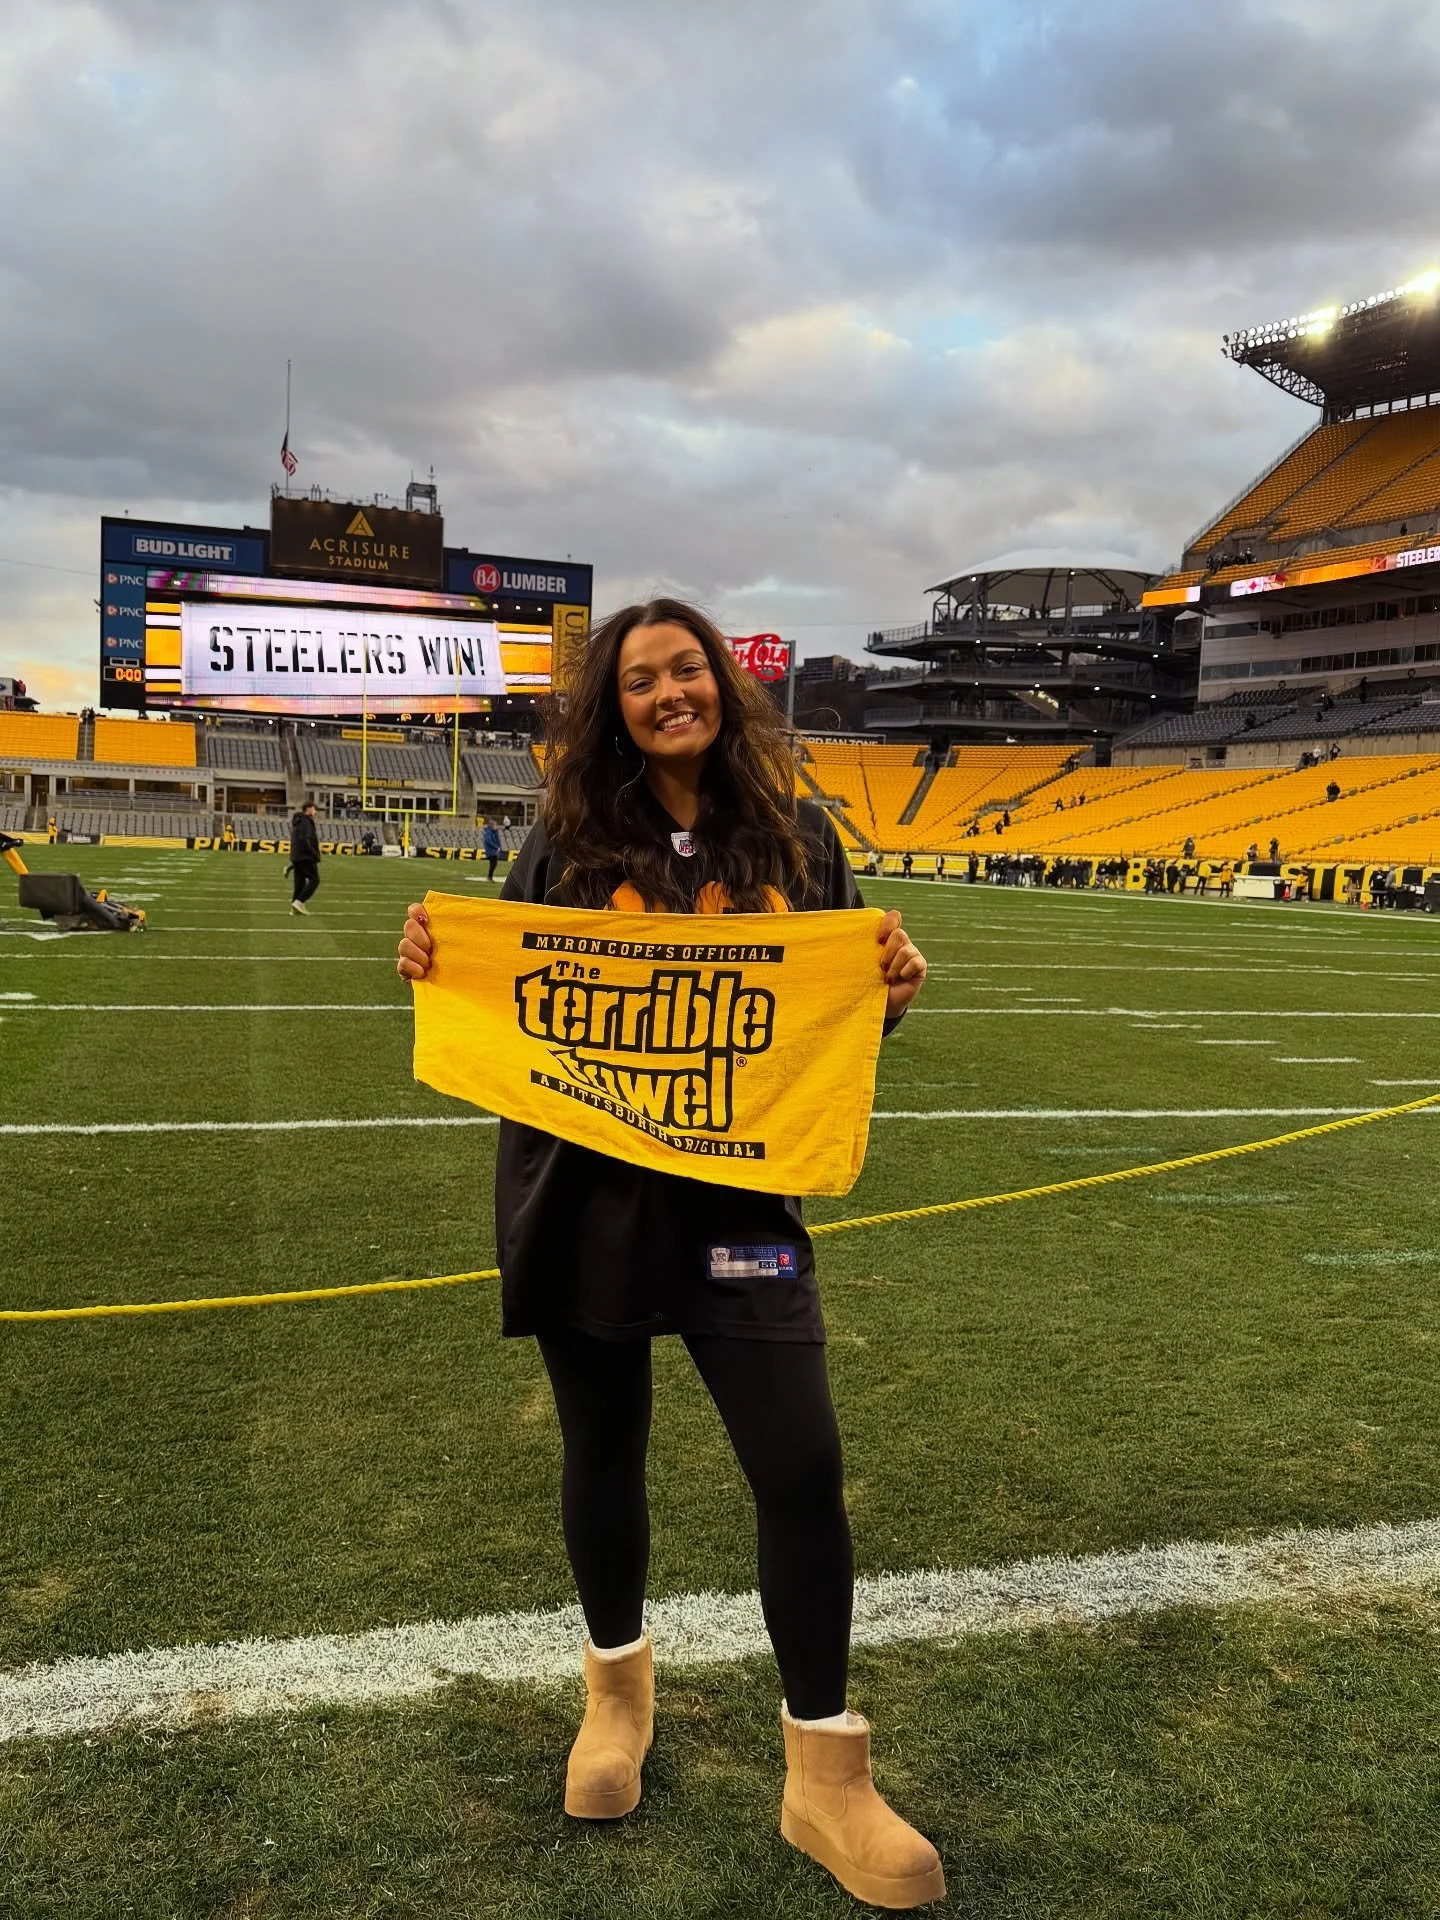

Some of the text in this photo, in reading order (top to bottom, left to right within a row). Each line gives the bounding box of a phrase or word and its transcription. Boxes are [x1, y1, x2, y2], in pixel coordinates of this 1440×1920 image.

[136, 538, 233, 561] BUD LIGHT
[309, 537, 411, 560] ACRISURE
[328, 555, 389, 570] STADIUM
[120, 574, 144, 586] PNC
[476, 568, 567, 594] 84 LUMBER
[120, 606, 143, 618] PNC
[119, 638, 144, 649] PNC
[209, 626, 486, 676] STEELERS WIN!
[115, 667, 142, 682] 0:00
[535, 936, 770, 961] MYRON COPE'S OFFICIAL
[556, 960, 601, 980] The
[515, 966, 775, 1054] terrible
[547, 1050, 733, 1133] towel
[540, 1073, 755, 1158] A PITTSBURGH ORIGINAL
